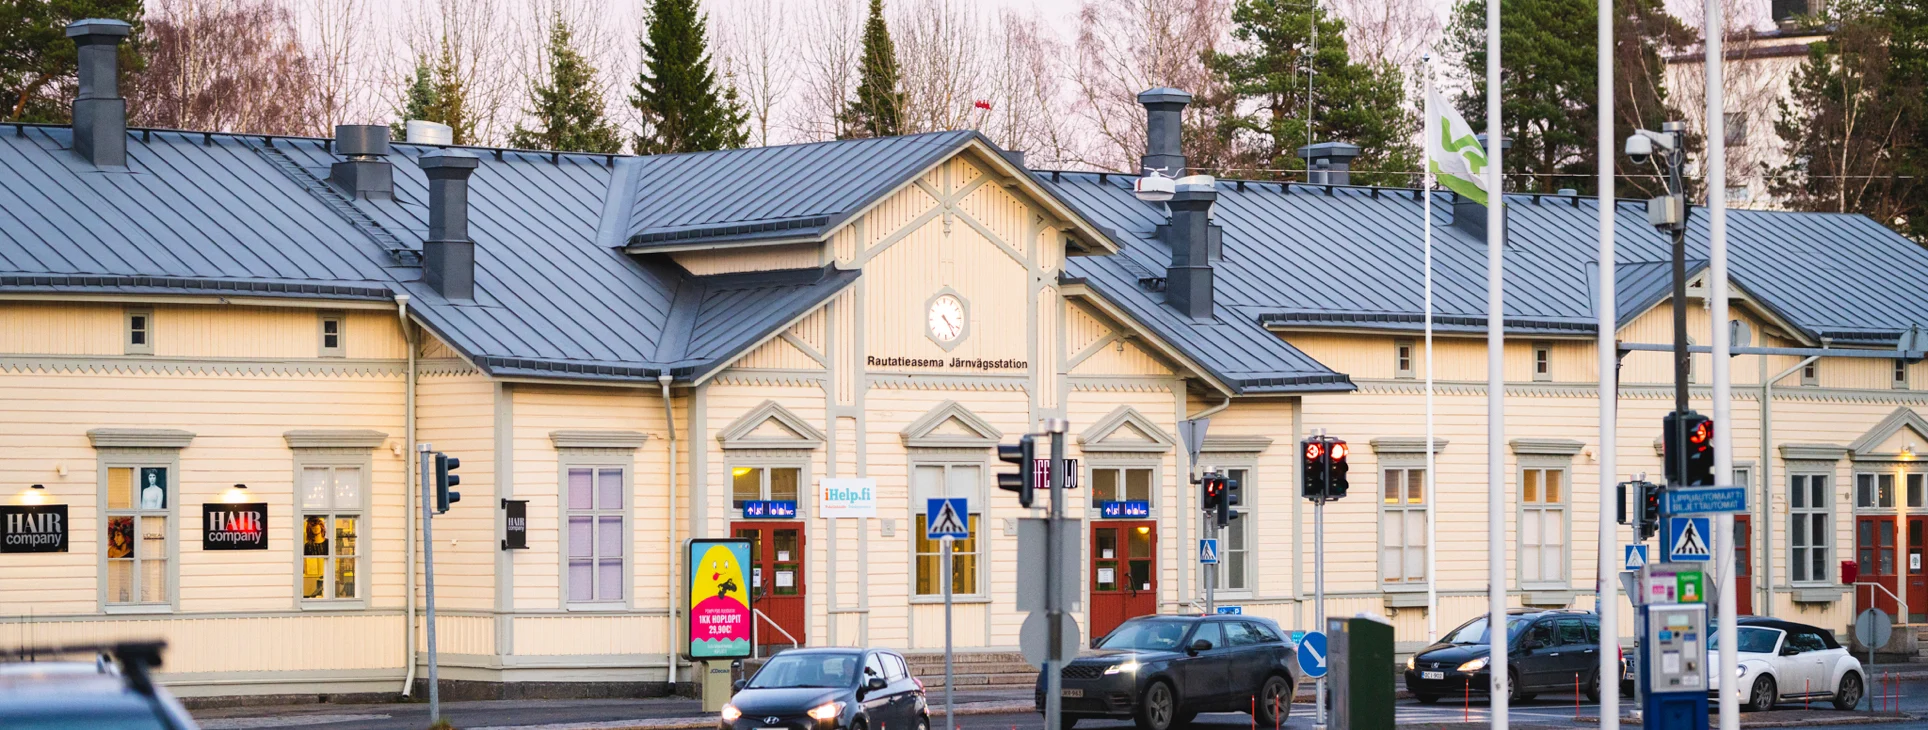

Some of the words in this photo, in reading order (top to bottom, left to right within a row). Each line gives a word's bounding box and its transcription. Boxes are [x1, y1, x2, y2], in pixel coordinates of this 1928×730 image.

[867, 355, 944, 367] Rautatieasema
[949, 357, 1028, 370] Järnvägsstation
[824, 488, 870, 503] iHelp.fi
[6, 513, 62, 533] HAIR
[208, 511, 263, 531] HAIR
[508, 517, 525, 526] HAIR
[6, 534, 62, 547] company
[208, 532, 262, 545] company
[712, 614, 741, 624] HOPLOPIT
